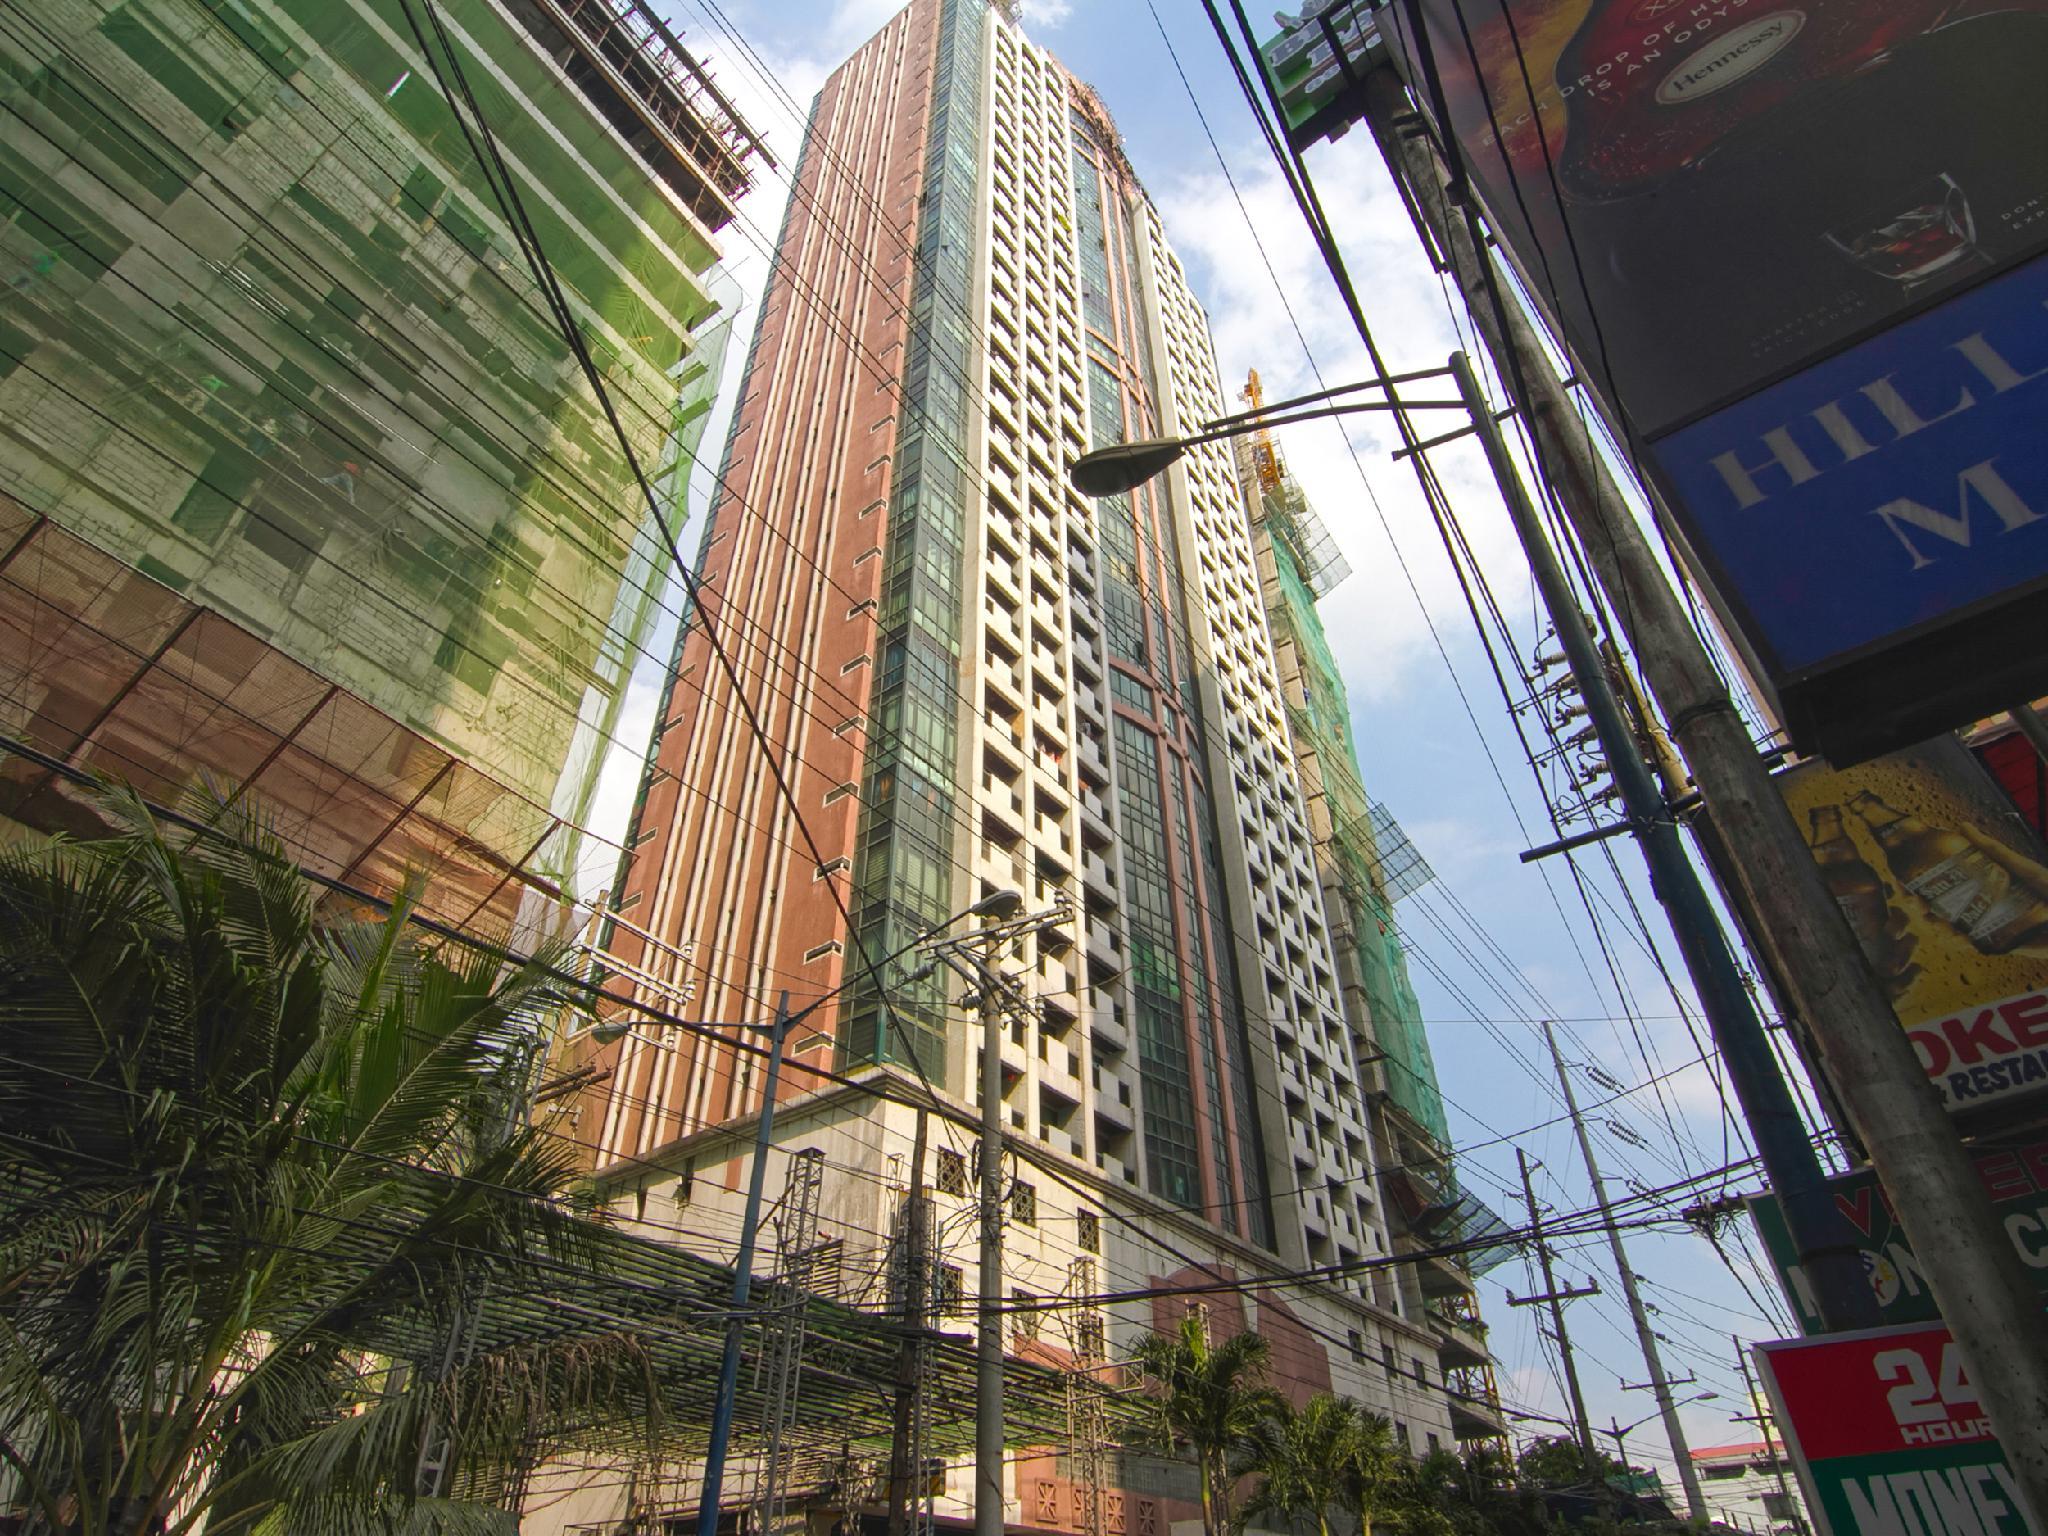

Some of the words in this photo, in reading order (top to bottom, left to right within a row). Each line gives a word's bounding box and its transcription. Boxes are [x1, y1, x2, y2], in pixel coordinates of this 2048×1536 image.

[1559, 50, 1630, 98] DROP
[1642, 19, 1677, 46] OF
[1588, 78, 1612, 98] IS
[1625, 49, 1662, 77] AN
[1672, 20, 1785, 93] Hennessy
[1707, 300, 2048, 512] HILL
[1873, 1341, 1979, 1426] 24
